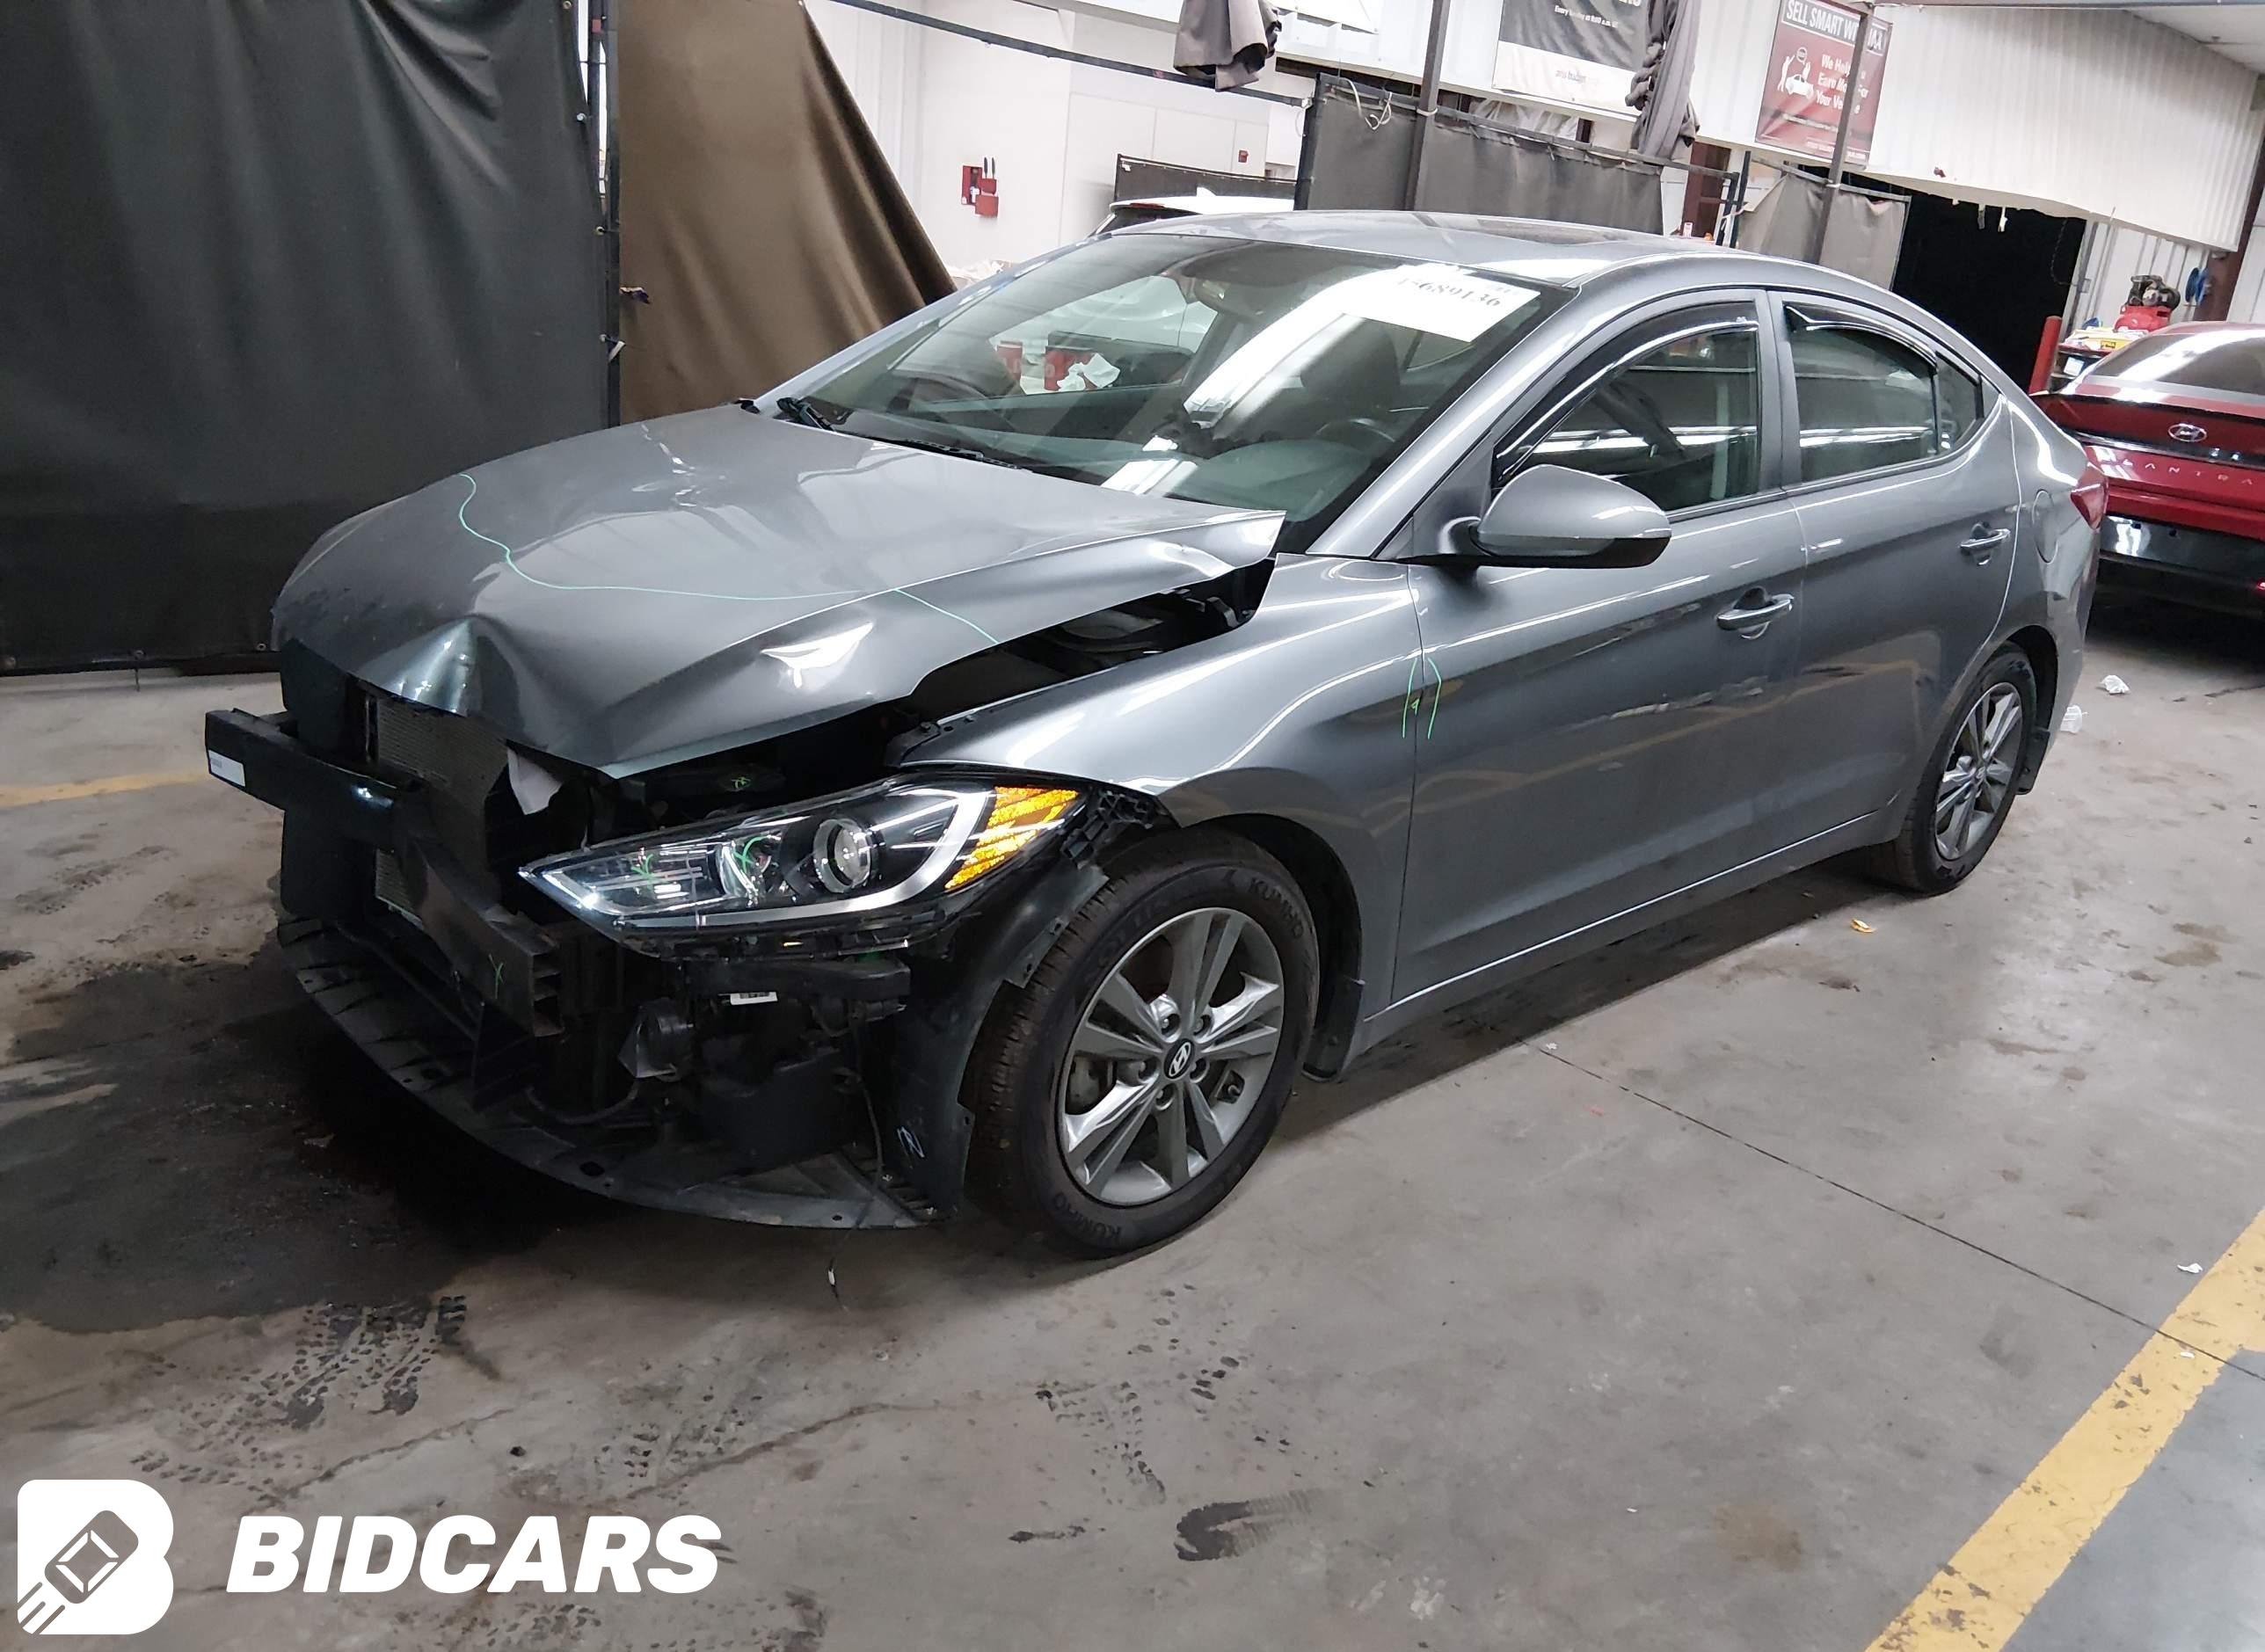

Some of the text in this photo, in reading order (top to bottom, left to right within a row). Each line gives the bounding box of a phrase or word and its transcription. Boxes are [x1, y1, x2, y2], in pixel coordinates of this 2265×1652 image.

[1787, 1, 1809, 27] SELL
[1810, 8, 1845, 36] SMART
[1821, 54, 1833, 69] We
[1817, 72, 1837, 89] Earn
[1816, 90, 1832, 106] Your
[1396, 278, 1502, 307] 689136
[2122, 459, 2253, 484] LANTRA
[1248, 877, 1304, 940] KUMHO
